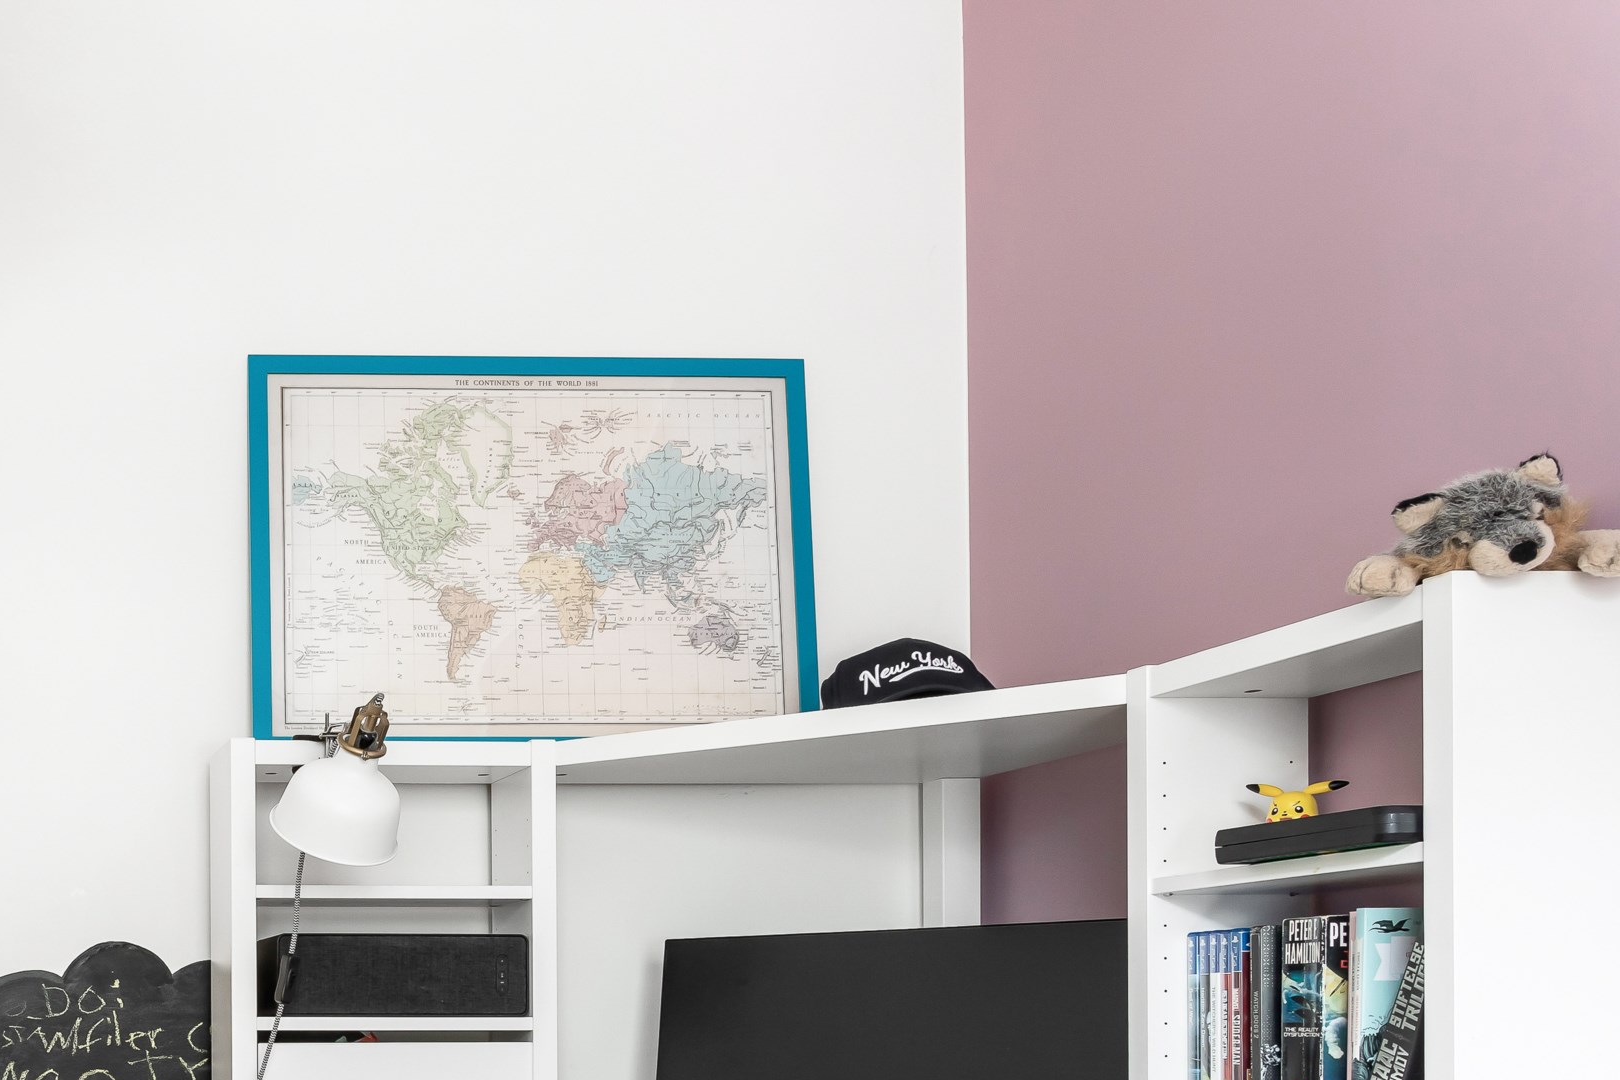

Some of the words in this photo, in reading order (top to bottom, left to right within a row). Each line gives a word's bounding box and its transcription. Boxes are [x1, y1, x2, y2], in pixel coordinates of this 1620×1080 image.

[455, 379, 469, 387] THE
[473, 379, 520, 387] CONTINENTS
[859, 661, 910, 696] New
[911, 651, 961, 673] York
[1288, 920, 1311, 942] PETER
[1330, 921, 1349, 948] PE
[1285, 941, 1321, 965] HAMILTON
[1388, 941, 1425, 1029] STIFTELSE
